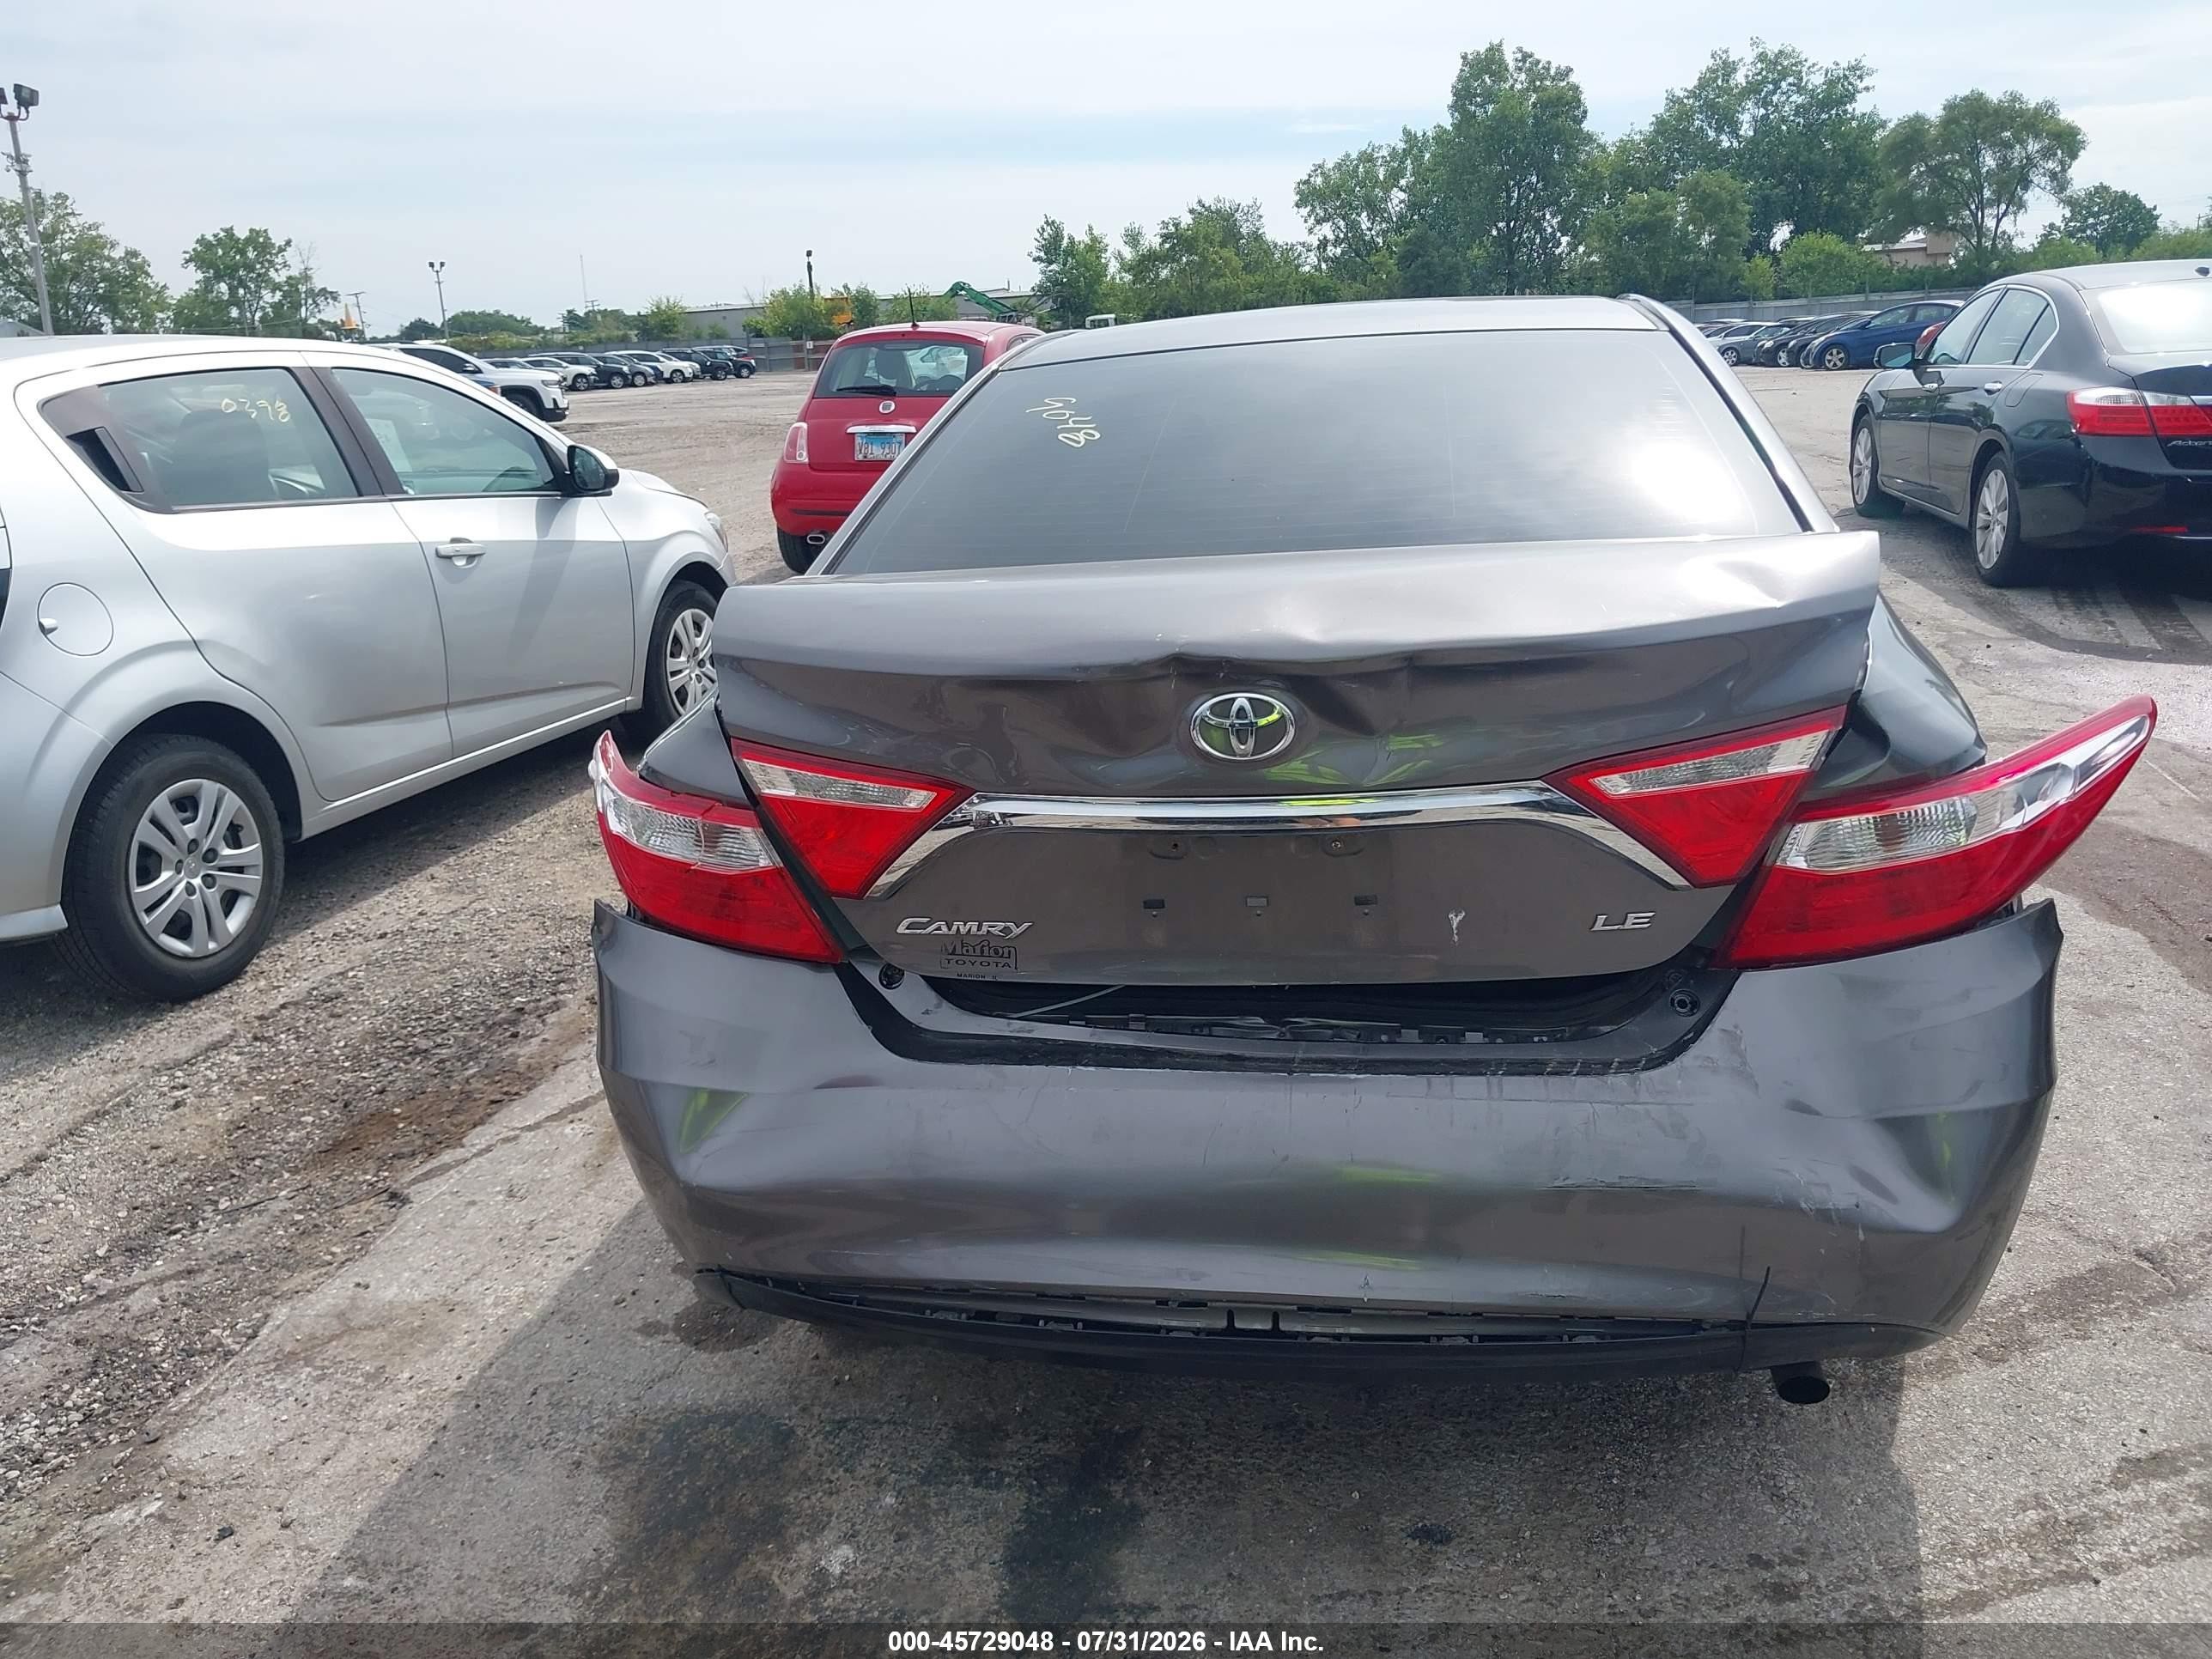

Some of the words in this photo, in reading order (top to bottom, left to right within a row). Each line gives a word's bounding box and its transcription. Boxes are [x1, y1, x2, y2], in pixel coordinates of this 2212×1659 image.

[221, 398, 290, 422] 0398
[1589, 911, 1656, 932] LE
[943, 939, 1018, 959] Marion
[946, 958, 1012, 969] TOYOTA
